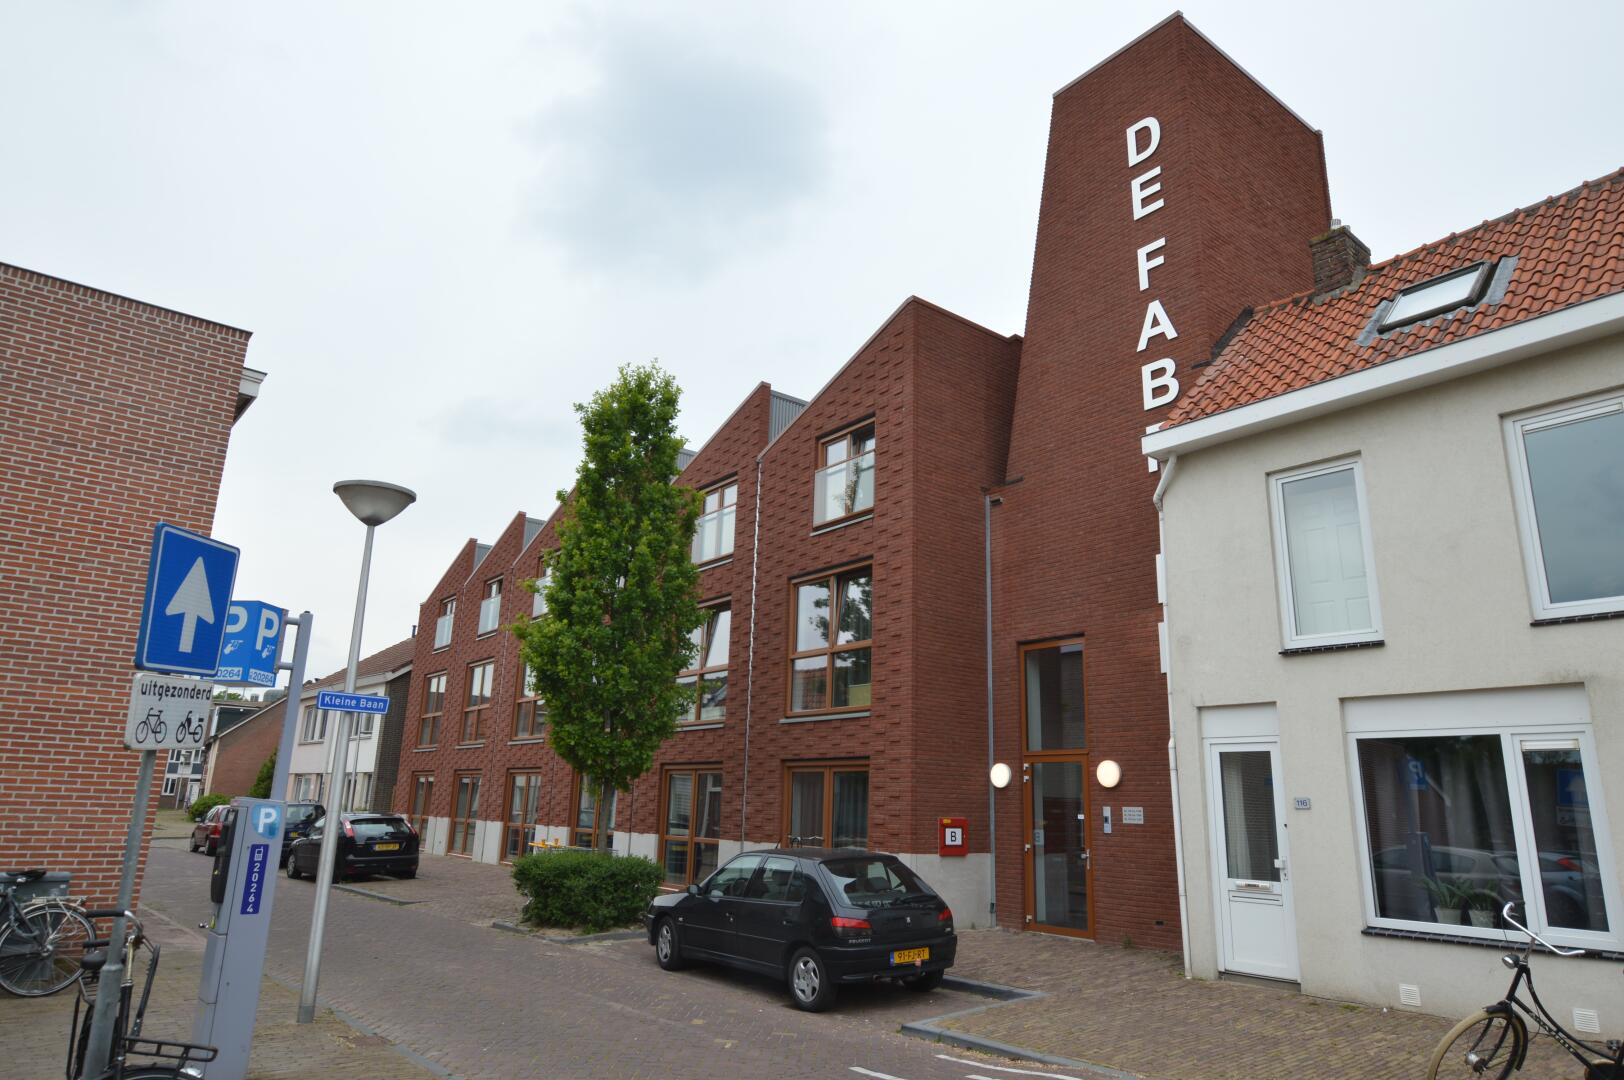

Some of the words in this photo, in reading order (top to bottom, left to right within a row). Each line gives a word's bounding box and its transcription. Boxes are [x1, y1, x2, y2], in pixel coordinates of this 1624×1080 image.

[1125, 116, 1165, 221] DE
[1136, 236, 1180, 473] FAB
[255, 608, 280, 651] P
[217, 669, 241, 678] 0264
[141, 680, 213, 701] uitgezonderd
[324, 695, 357, 707] Kleine
[359, 698, 384, 709] Baan
[1296, 799, 1308, 807] 116
[258, 807, 277, 833] P
[950, 831, 957, 842] B
[246, 863, 261, 913] 20264
